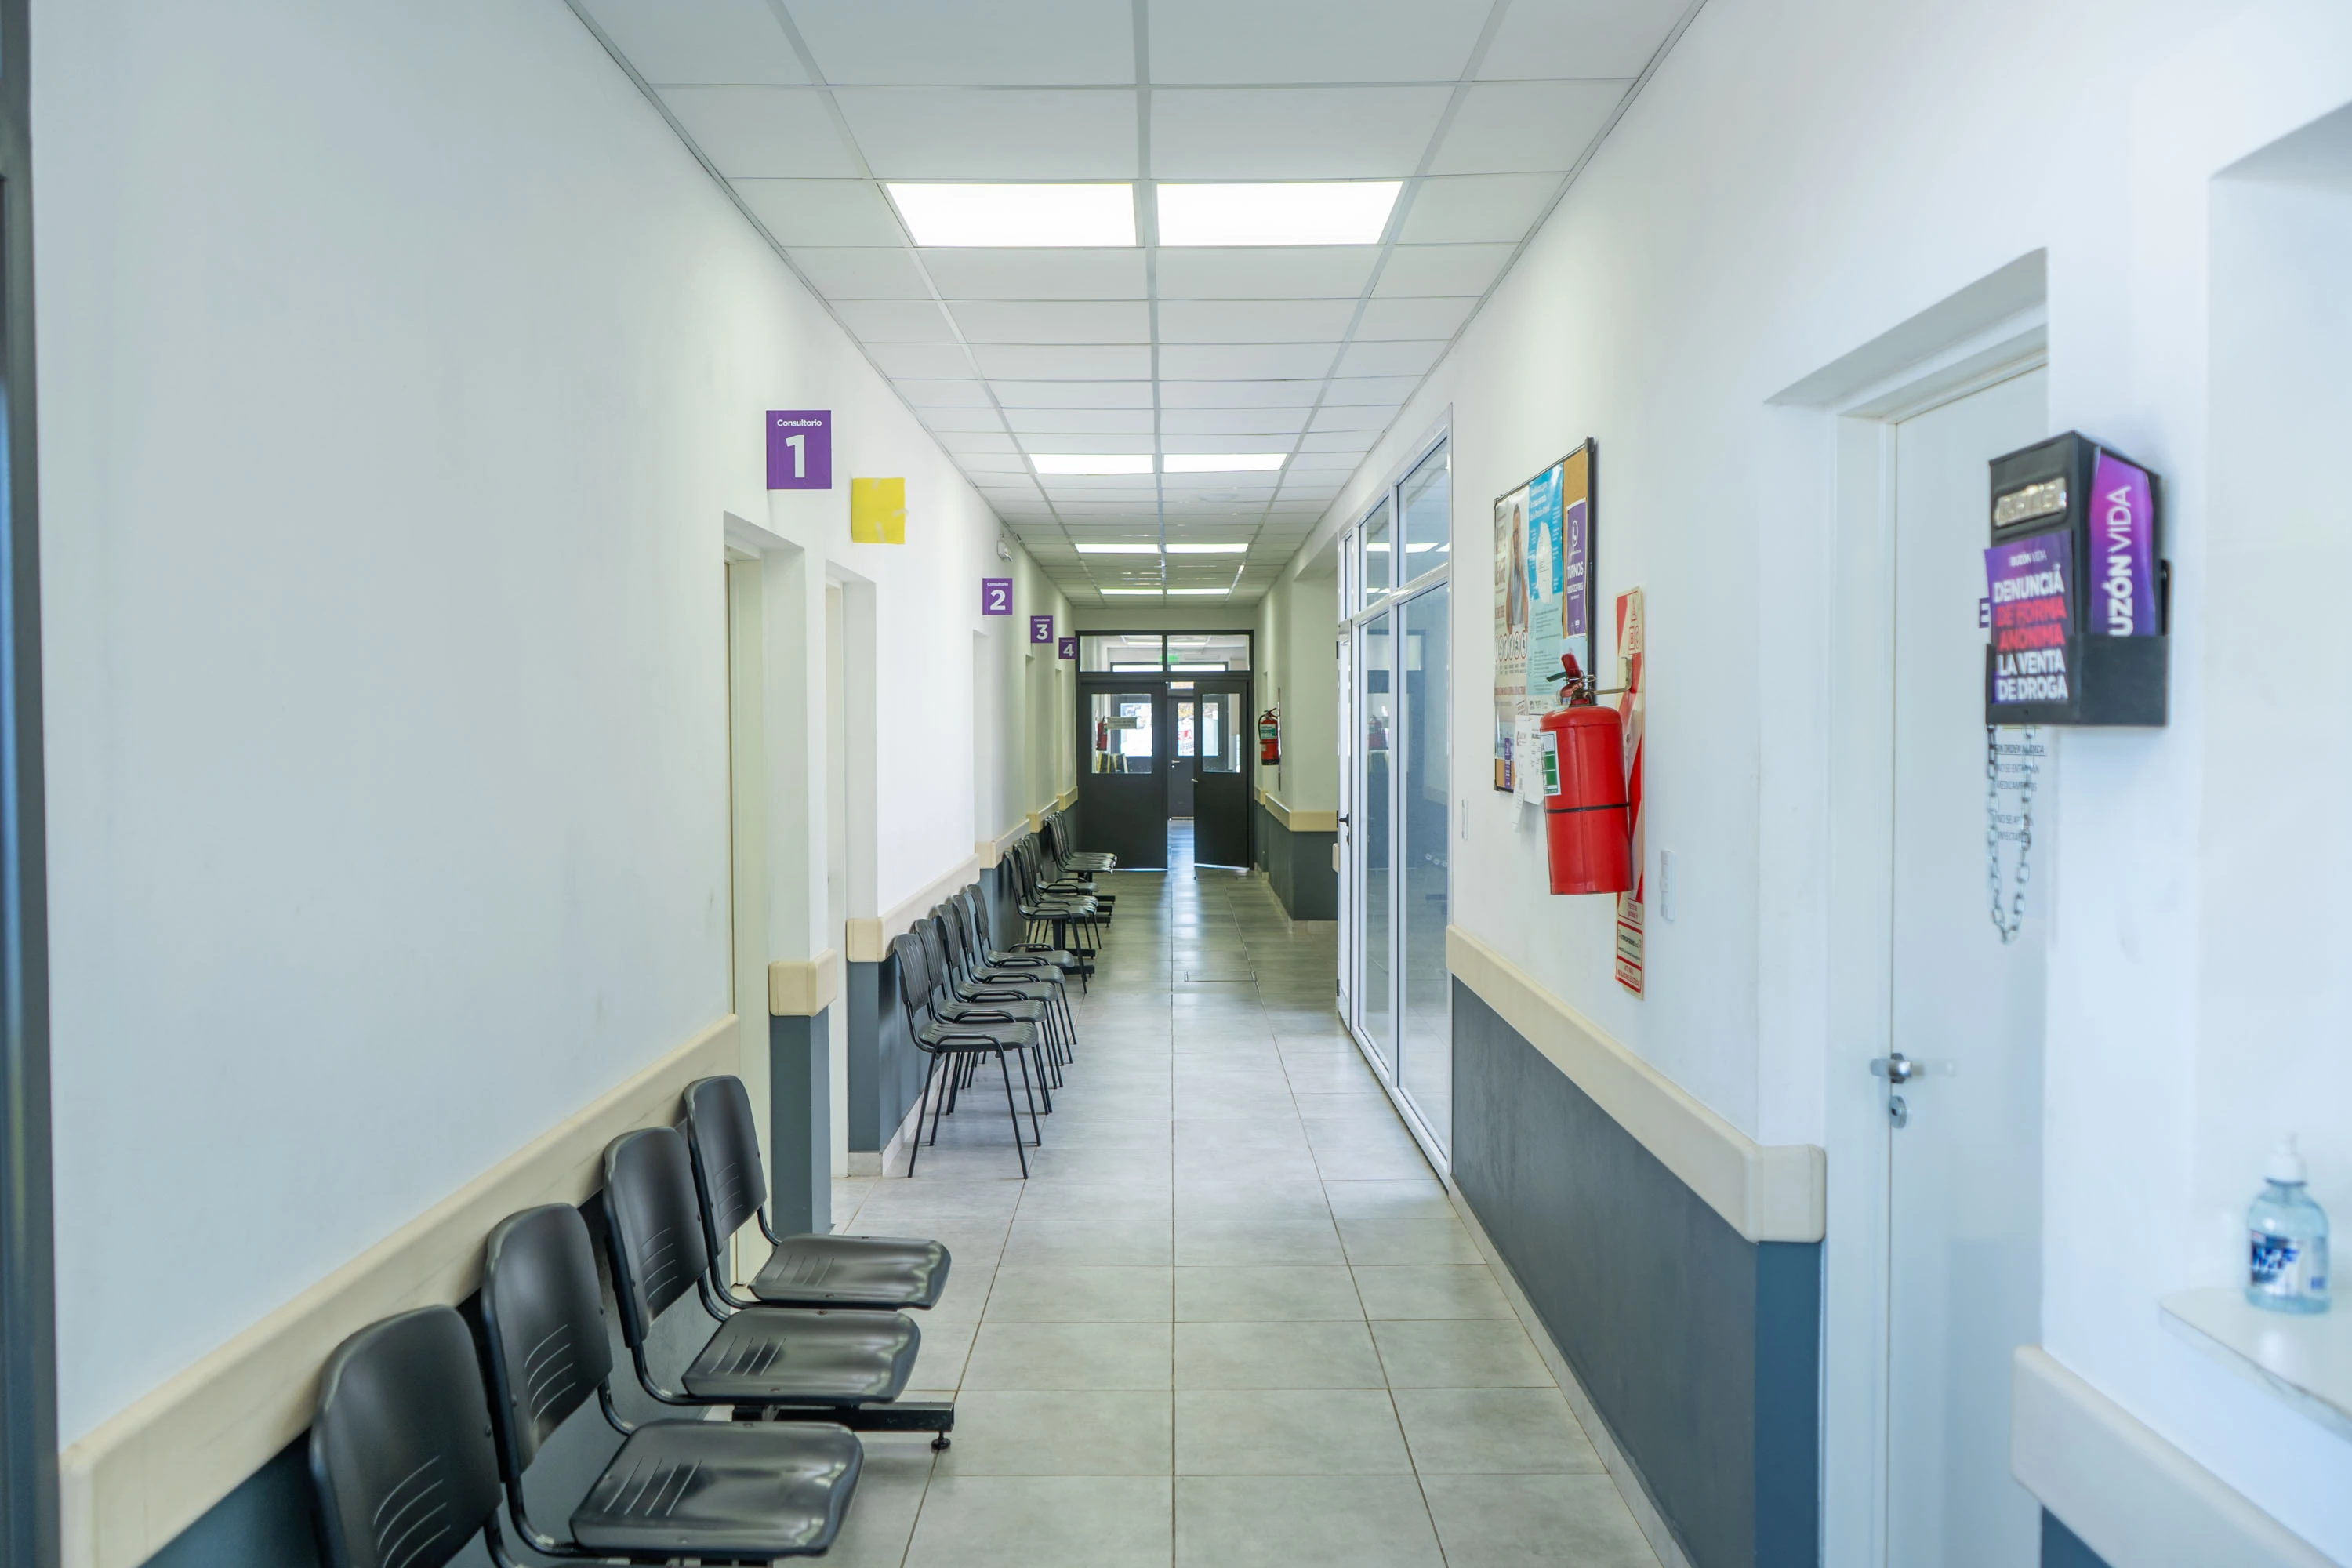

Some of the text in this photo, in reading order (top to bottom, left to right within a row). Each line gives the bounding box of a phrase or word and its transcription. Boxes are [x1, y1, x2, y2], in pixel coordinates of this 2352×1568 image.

[777, 419, 822, 427] Consultorio
[785, 434, 805, 478] 1
[2101, 485, 2134, 637] UZÓN VIDA
[1993, 562, 2065, 603] DENUNCIÁ
[989, 590, 1006, 611] 2
[1996, 596, 2067, 627] DE FORMA
[1036, 624, 1048, 641] 3
[1063, 644, 1074, 657] 4
[1998, 648, 2067, 677] LA VENTA
[1998, 674, 2069, 701] DE DROGA
